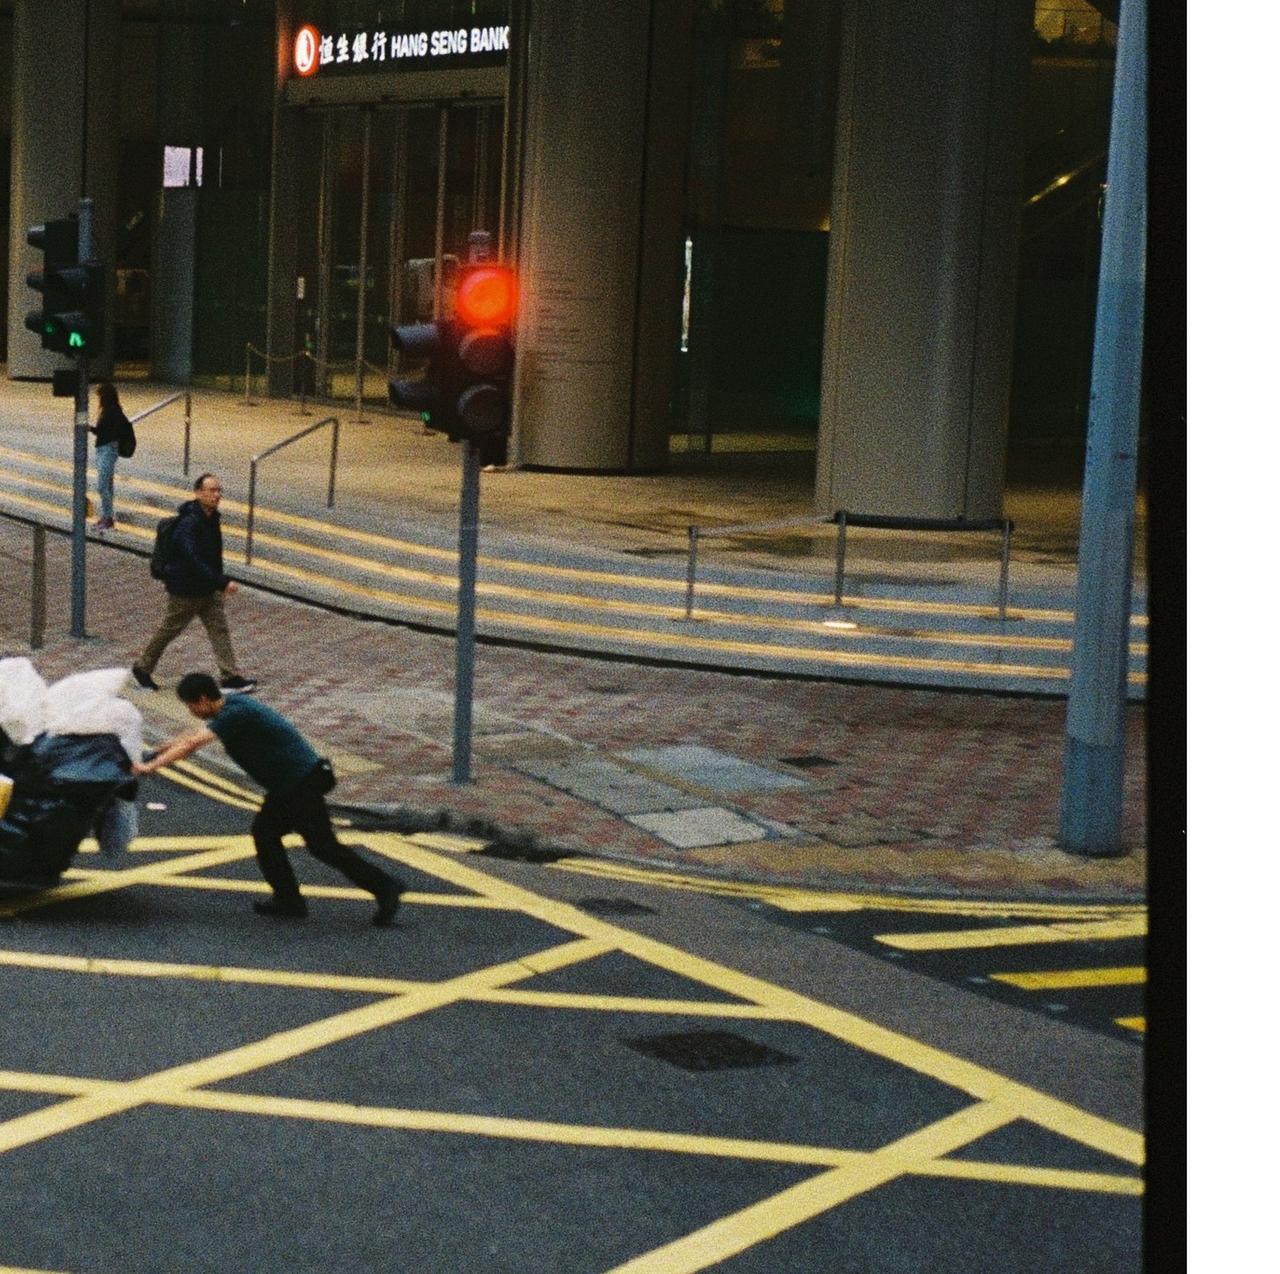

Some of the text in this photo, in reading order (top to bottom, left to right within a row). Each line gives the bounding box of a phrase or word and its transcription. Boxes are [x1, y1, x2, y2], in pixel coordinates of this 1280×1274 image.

[391, 26, 510, 59] HANG SENG BANK
